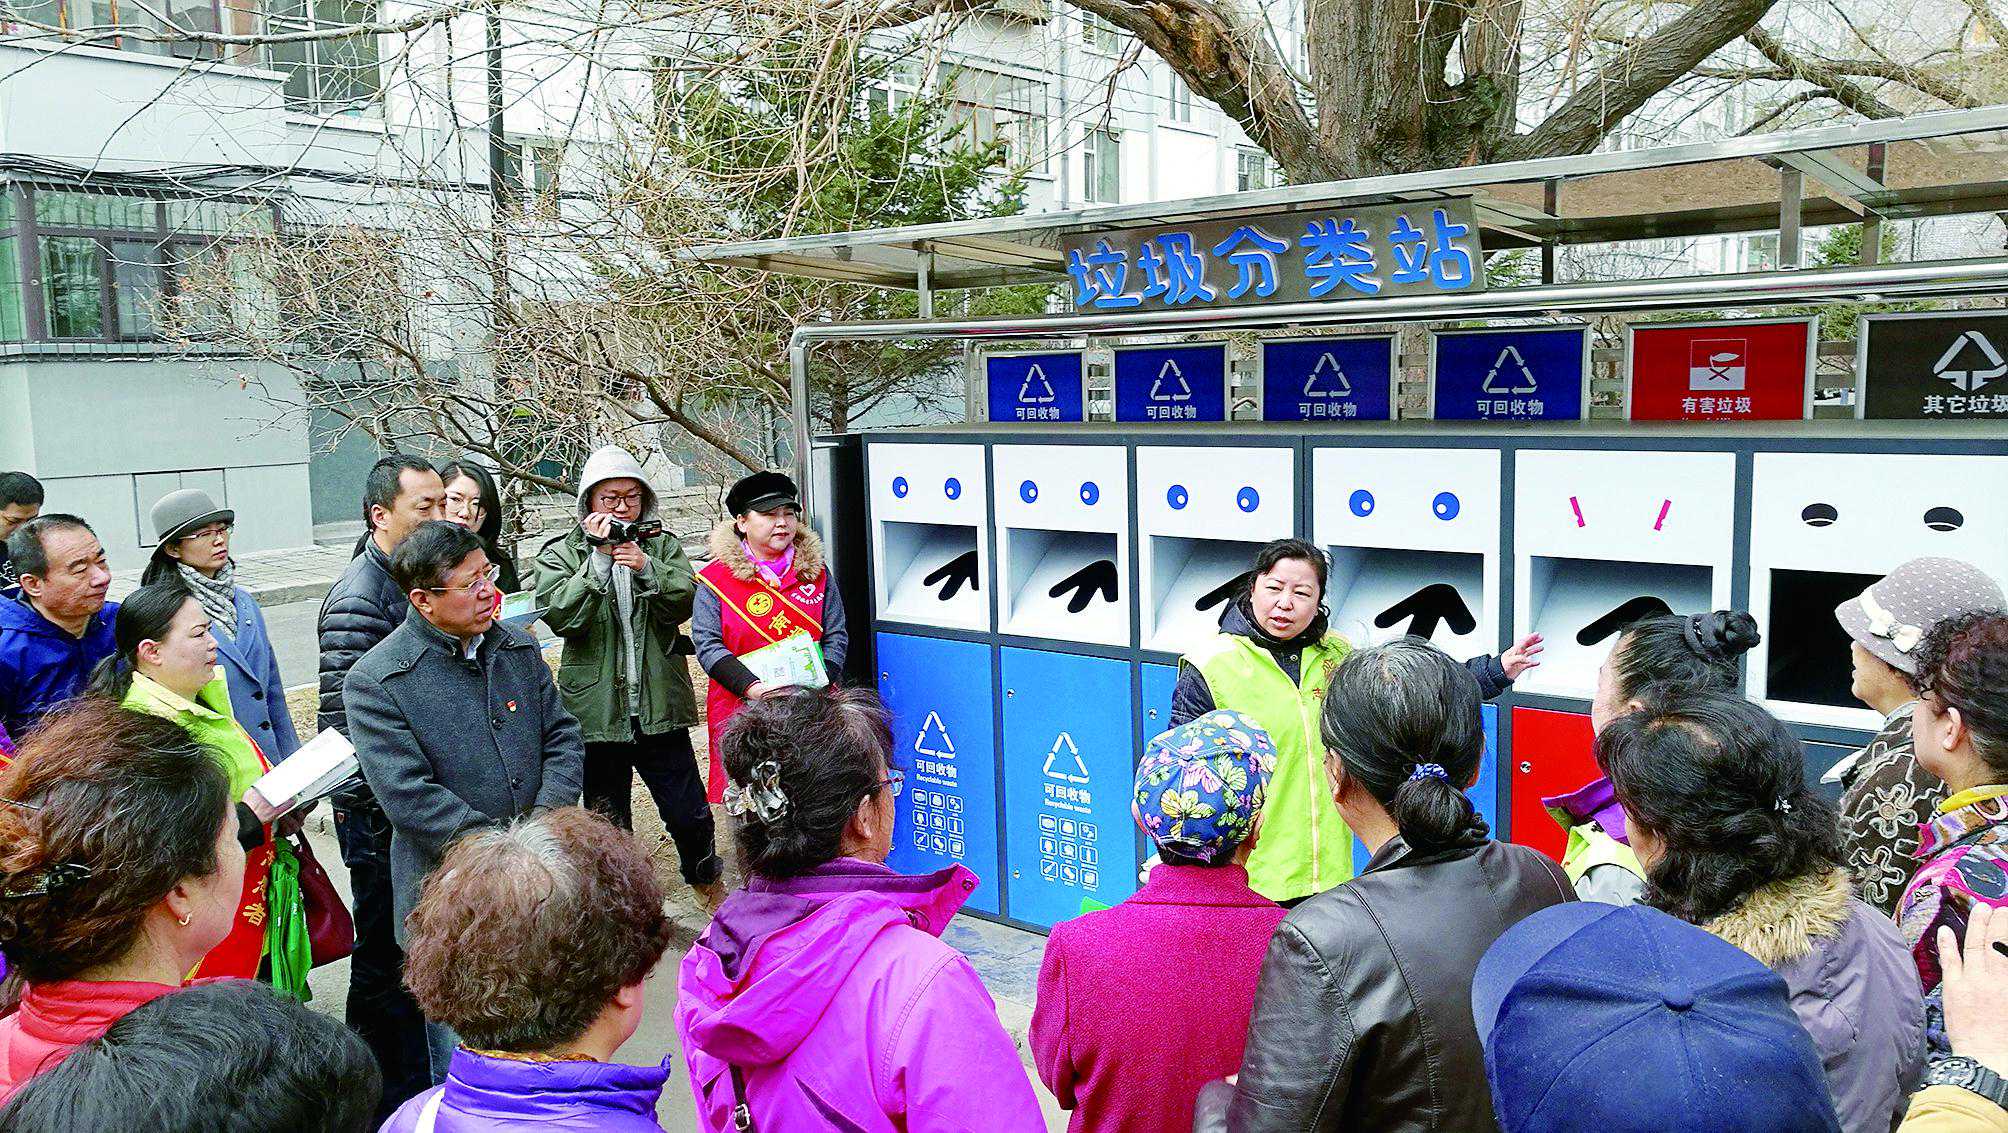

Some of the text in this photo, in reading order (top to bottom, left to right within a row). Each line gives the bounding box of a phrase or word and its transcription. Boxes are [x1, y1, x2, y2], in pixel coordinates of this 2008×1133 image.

[1067, 207, 1473, 308] 垃圾分类站
[1015, 407, 1060, 420] 可回收物
[1146, 405, 1197, 419] 可回收物
[1298, 402, 1358, 417] 可回收物
[1476, 399, 1545, 416] 可回收物
[1681, 396, 1753, 415] 有害垃圾
[1923, 394, 2008, 414] 其它垃圾
[915, 759, 957, 779] 可回收物
[1043, 783, 1091, 805] 可回收物
